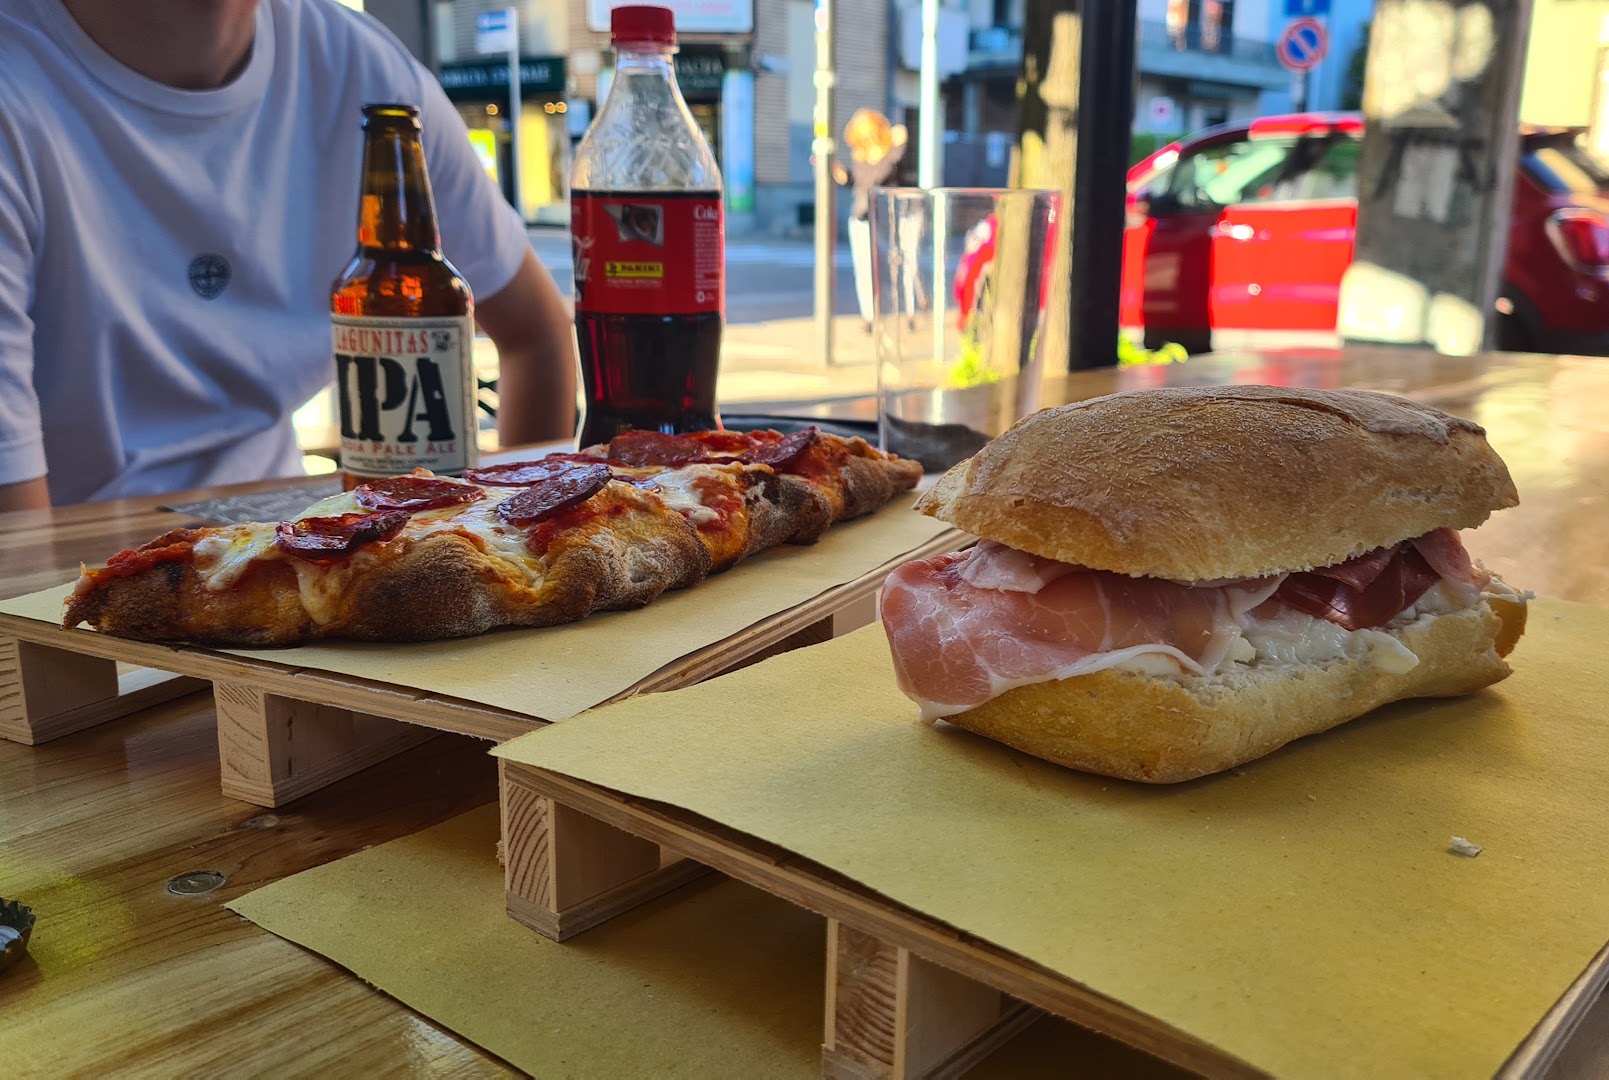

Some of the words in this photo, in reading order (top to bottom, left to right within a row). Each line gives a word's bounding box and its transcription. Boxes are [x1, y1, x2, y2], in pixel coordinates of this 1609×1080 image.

[621, 263, 661, 272] PANINI
[336, 328, 429, 353] LAGUNITAS
[335, 354, 456, 442] IPA
[372, 442, 416, 455] PALE
[426, 441, 456, 454] ALE
